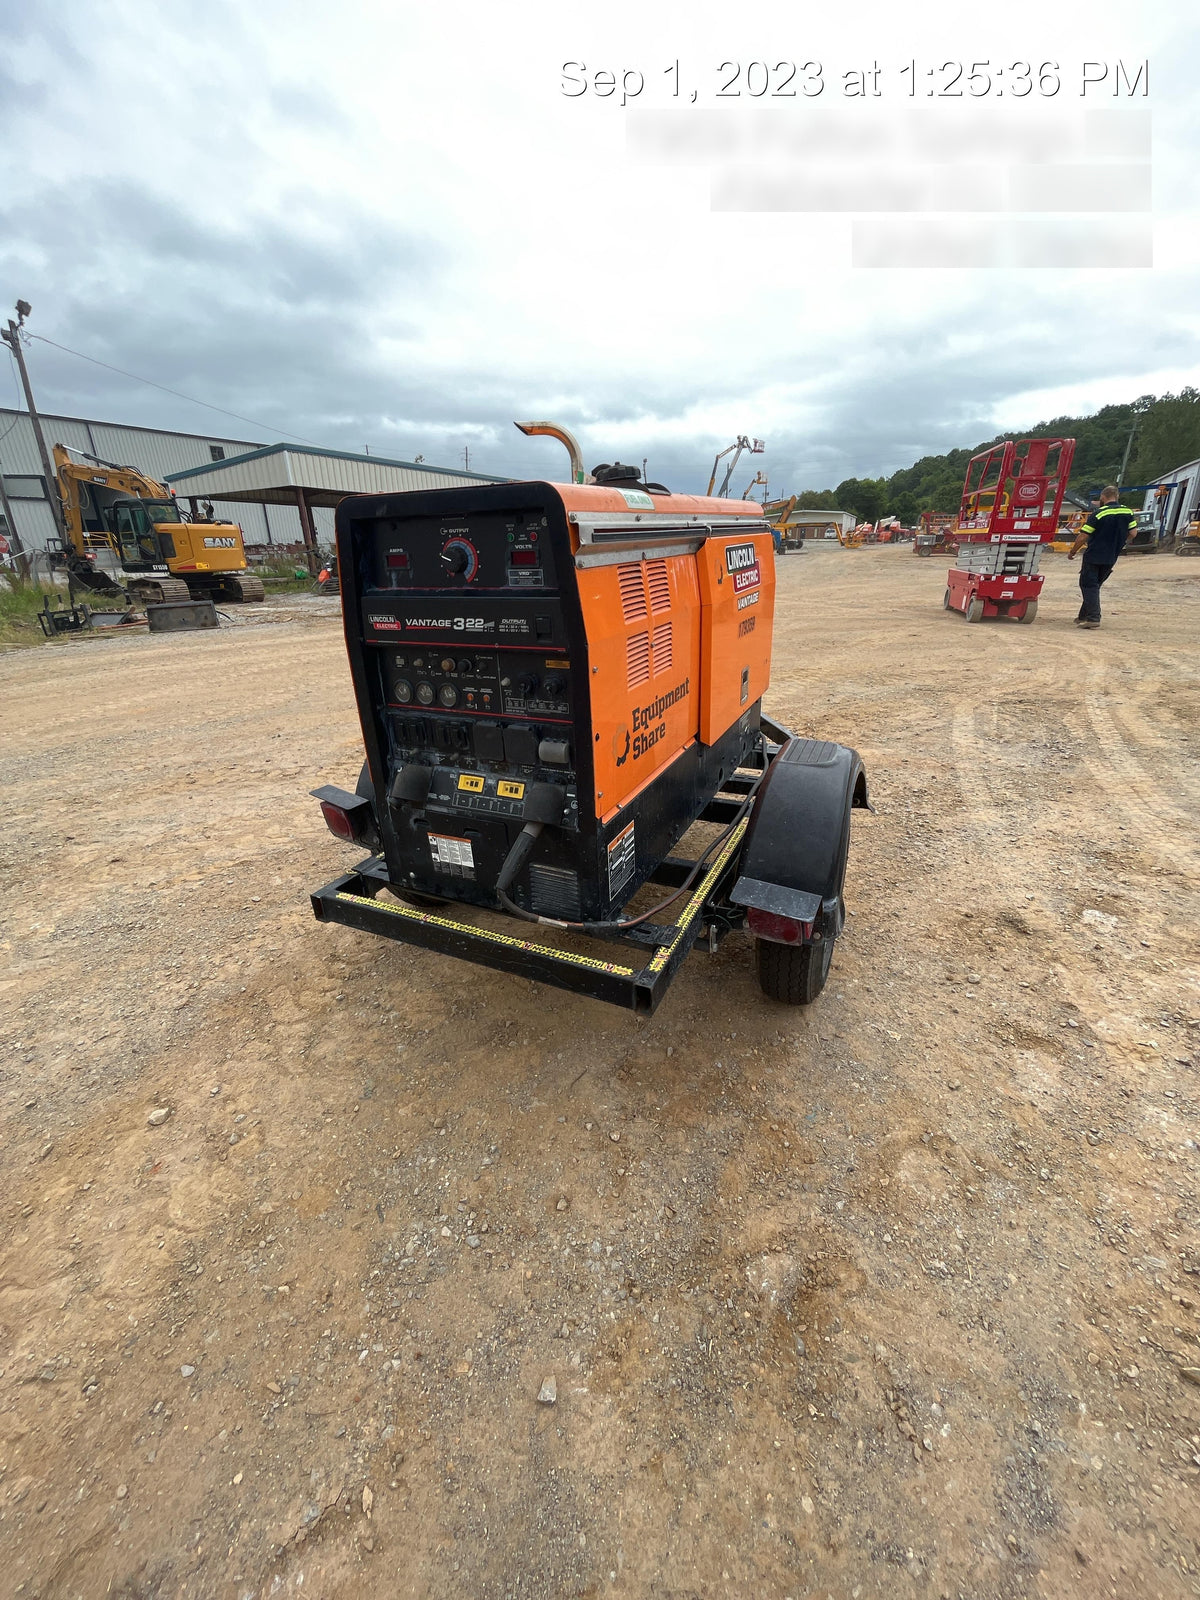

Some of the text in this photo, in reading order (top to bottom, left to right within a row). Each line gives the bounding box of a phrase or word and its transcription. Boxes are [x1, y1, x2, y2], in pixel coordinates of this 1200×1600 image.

[203, 537, 236, 548] SANY
[726, 547, 755, 571] LINCOLN
[735, 569, 759, 589] ELECTRIC
[369, 616, 395, 624] LINCOLN
[405, 618, 452, 628] VANTAGE
[453, 617, 485, 630] 322
[631, 676, 690, 734] Equipment
[632, 721, 666, 760] Share
